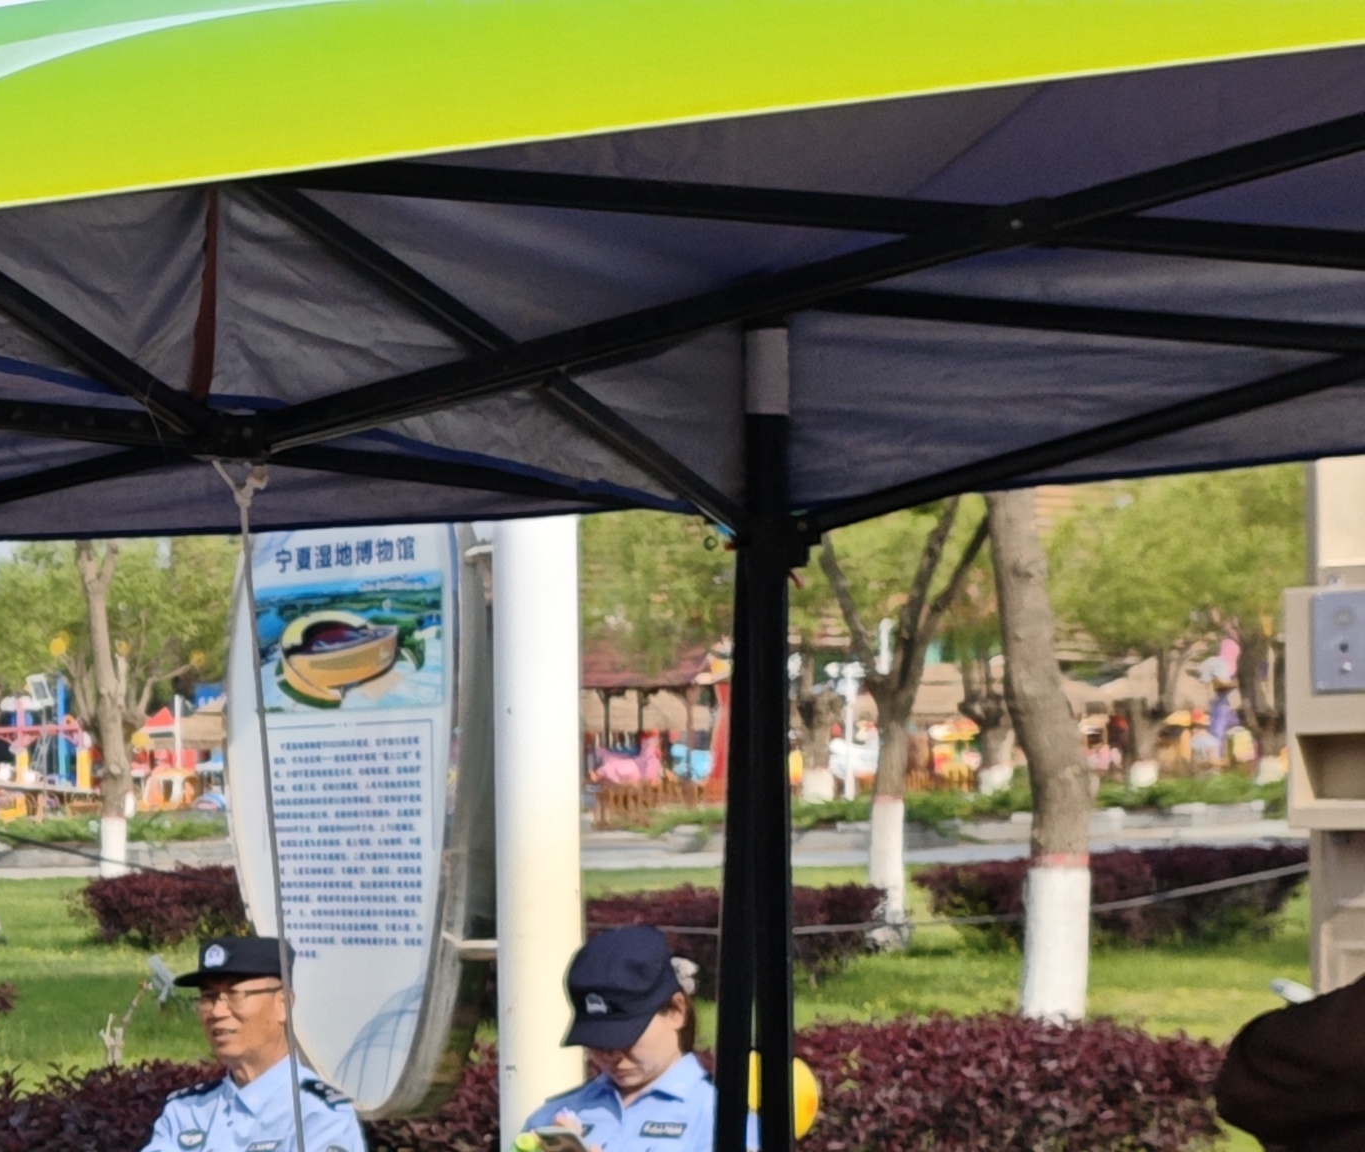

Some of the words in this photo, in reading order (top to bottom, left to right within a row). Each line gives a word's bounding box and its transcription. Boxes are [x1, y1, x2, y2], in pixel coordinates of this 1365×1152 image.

[274, 535, 416, 574] 宁夏湿地博物馆
